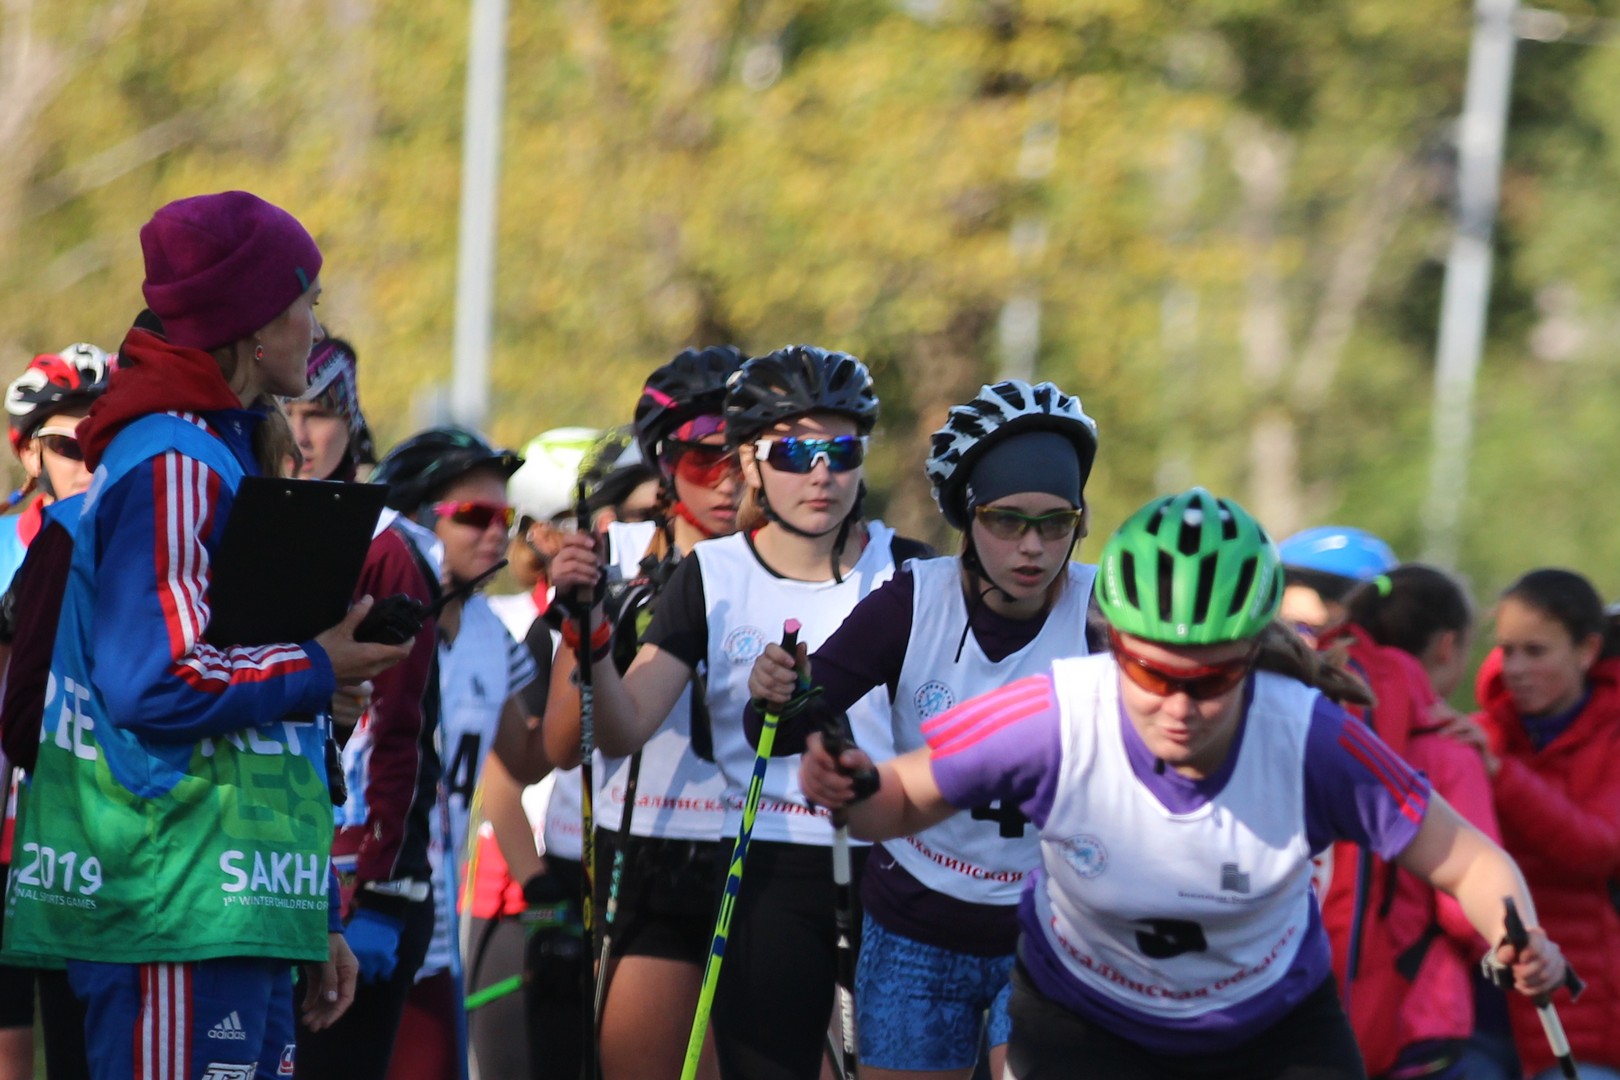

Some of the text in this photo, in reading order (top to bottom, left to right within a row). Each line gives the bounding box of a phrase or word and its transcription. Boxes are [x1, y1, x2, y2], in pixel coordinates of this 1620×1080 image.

[906, 834, 1024, 883] ахалинская
[17, 842, 104, 896] 2019
[66, 896, 98, 911] GAMES
[239, 895, 274, 907] WINTER
[274, 897, 314, 911] CHILDREN
[208, 1029, 246, 1040] adidas
